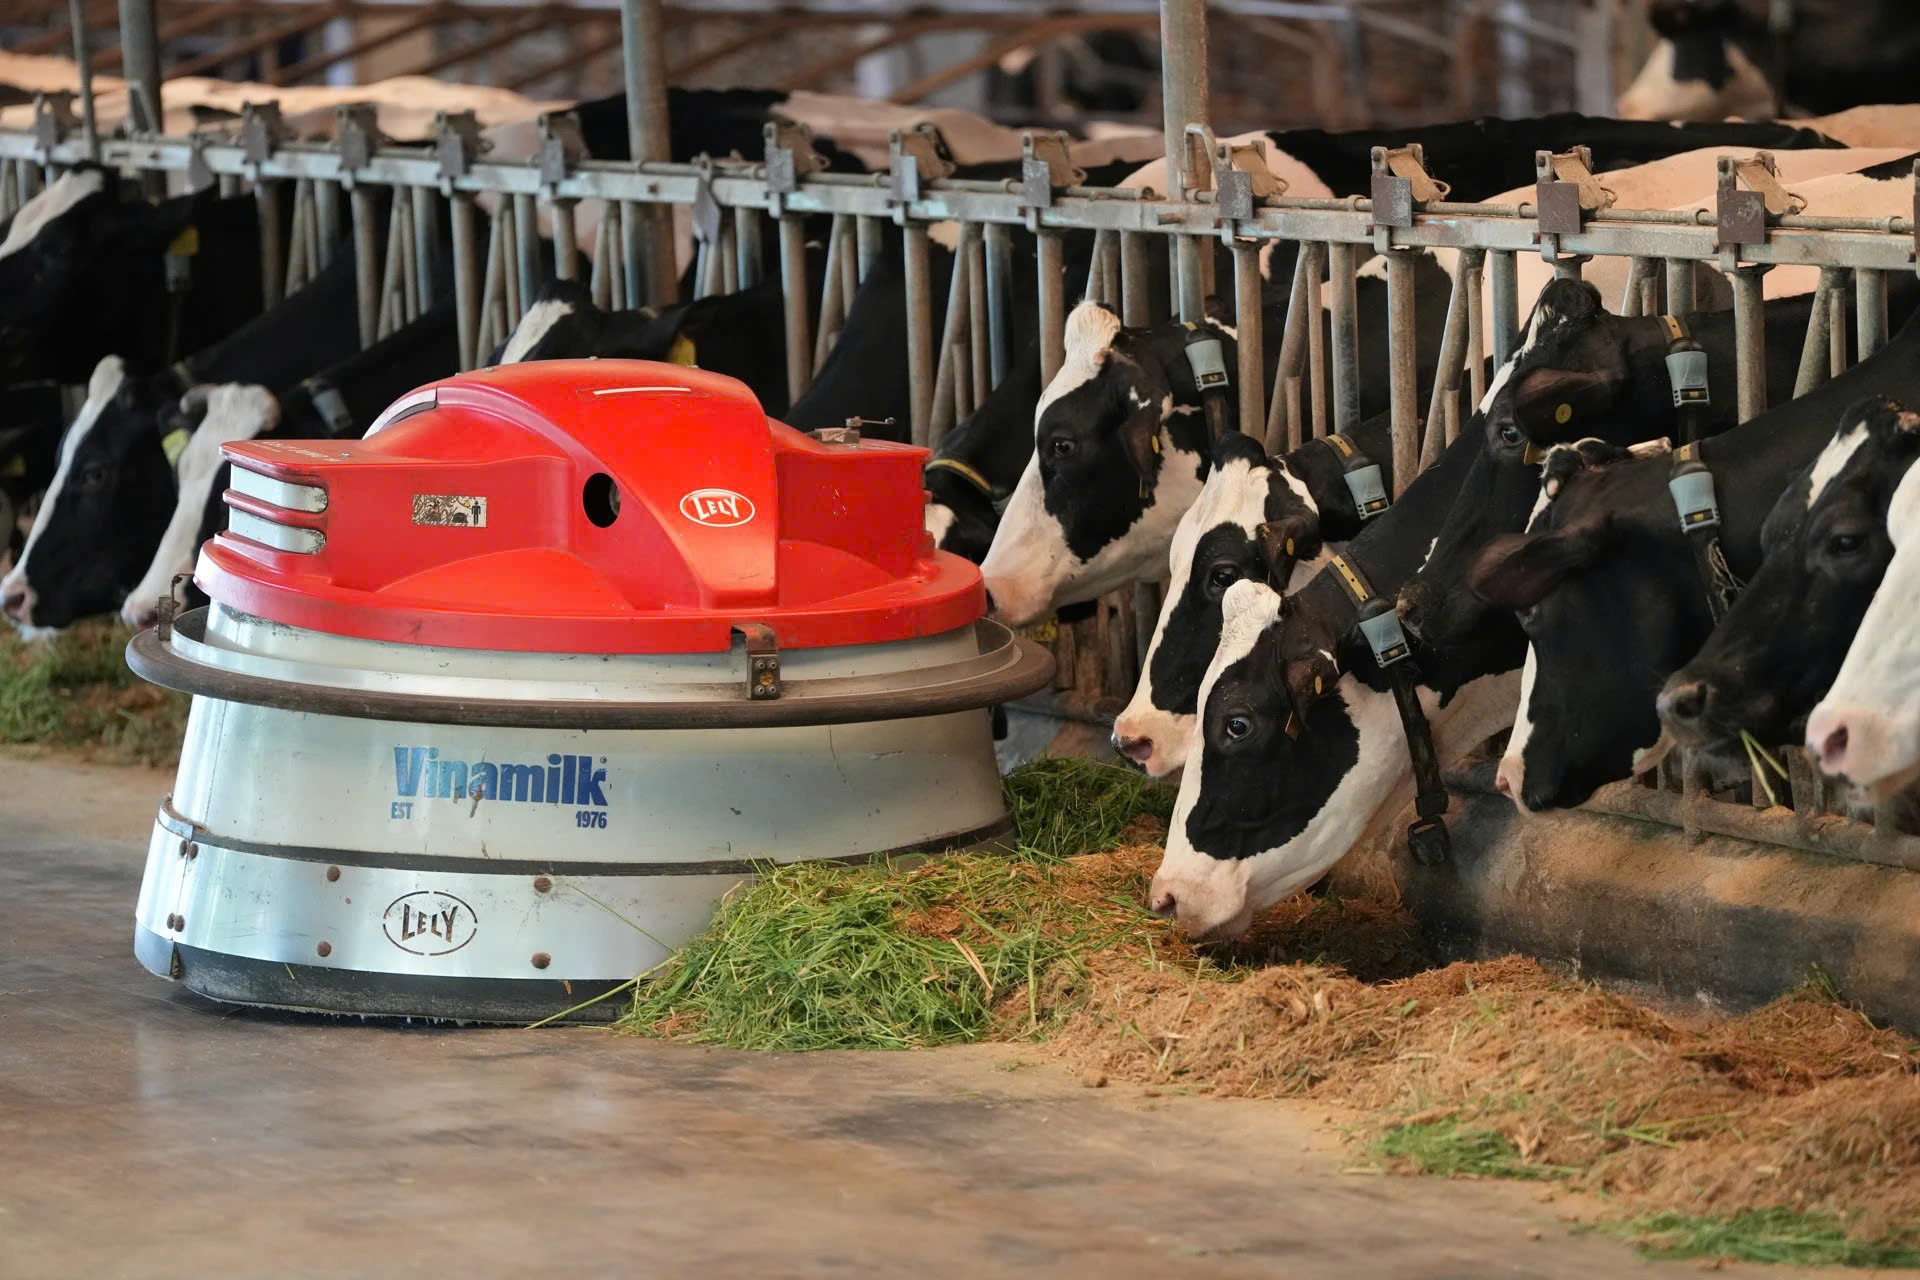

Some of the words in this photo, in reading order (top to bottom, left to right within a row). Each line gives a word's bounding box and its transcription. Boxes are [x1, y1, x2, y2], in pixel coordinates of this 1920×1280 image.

[692, 495, 740, 520] LELY
[391, 802, 413, 819] EST
[576, 811, 608, 829] 1976
[402, 903, 458, 943] LELY
